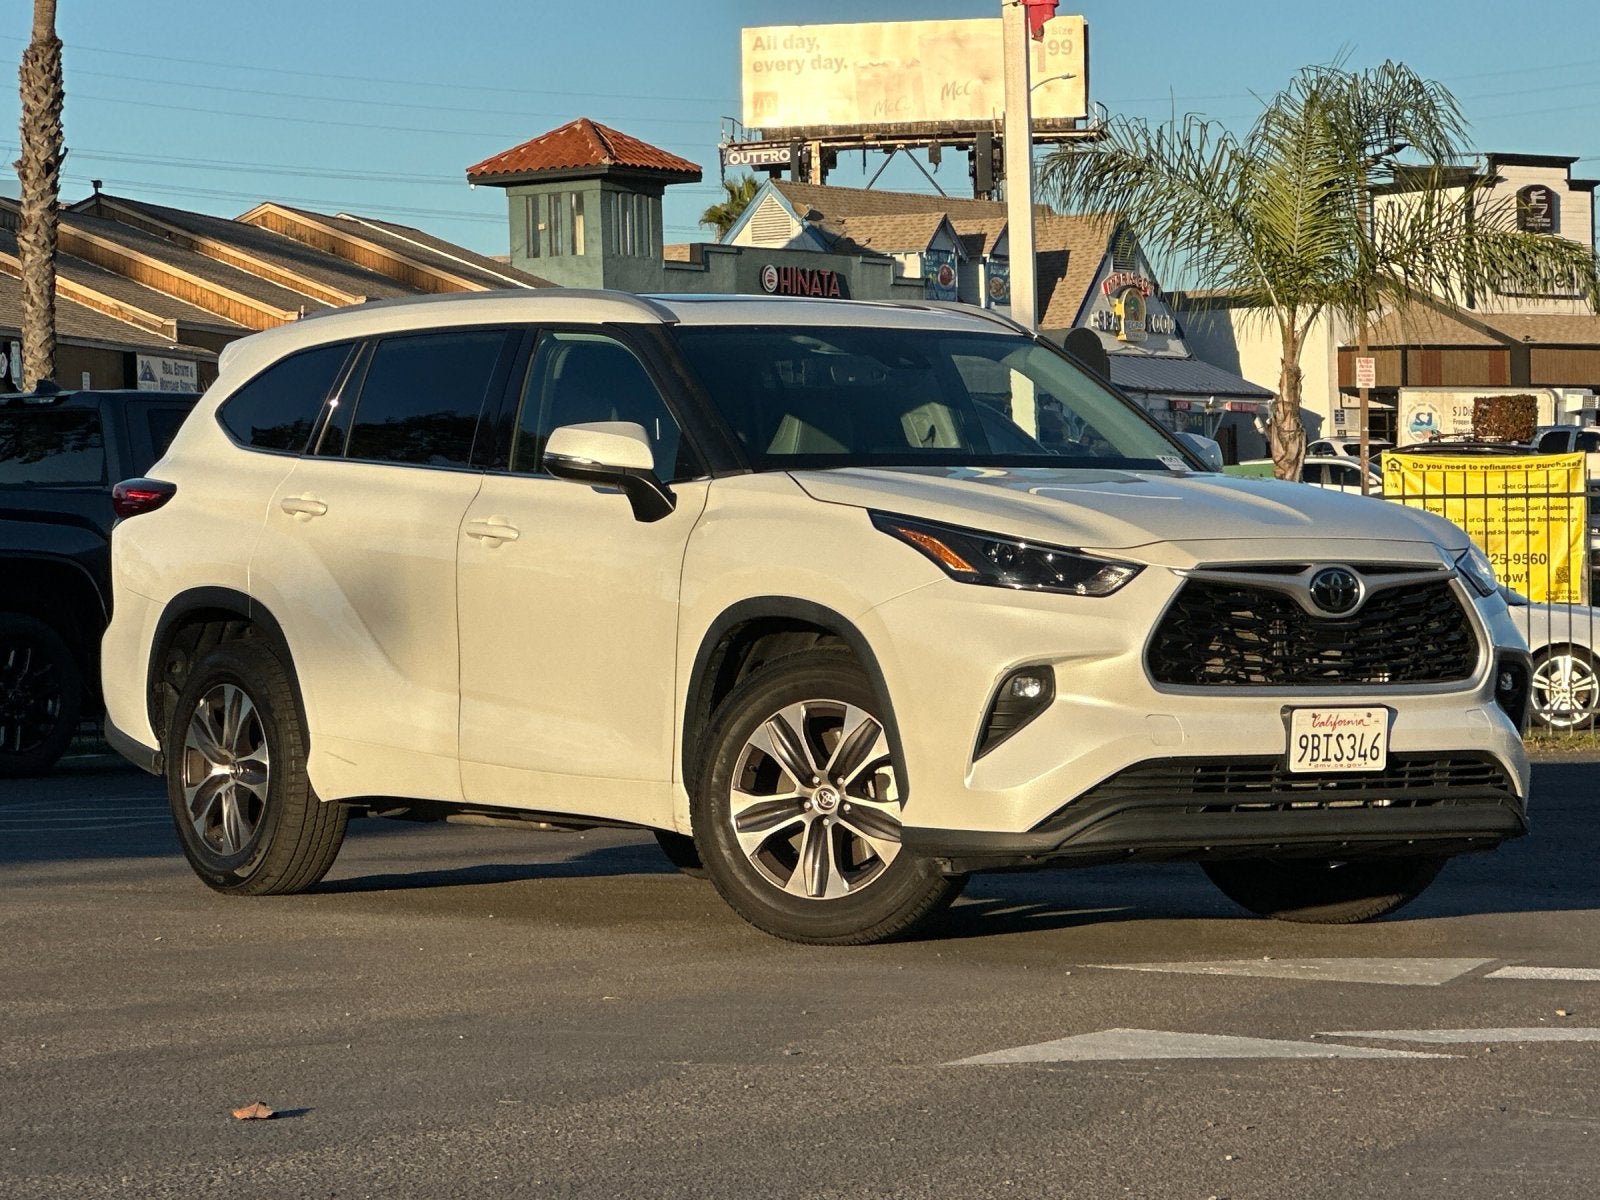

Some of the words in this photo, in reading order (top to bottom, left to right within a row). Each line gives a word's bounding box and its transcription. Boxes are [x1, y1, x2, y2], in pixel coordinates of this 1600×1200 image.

[752, 35, 778, 51] All
[783, 33, 821, 51] day,
[752, 56, 806, 75] every
[810, 54, 848, 74] day.
[729, 149, 791, 165] OUTFRO
[779, 265, 841, 297] HINATA
[1426, 463, 1442, 471] you
[1312, 713, 1371, 732] California
[1297, 732, 1382, 763] 9BIS346
